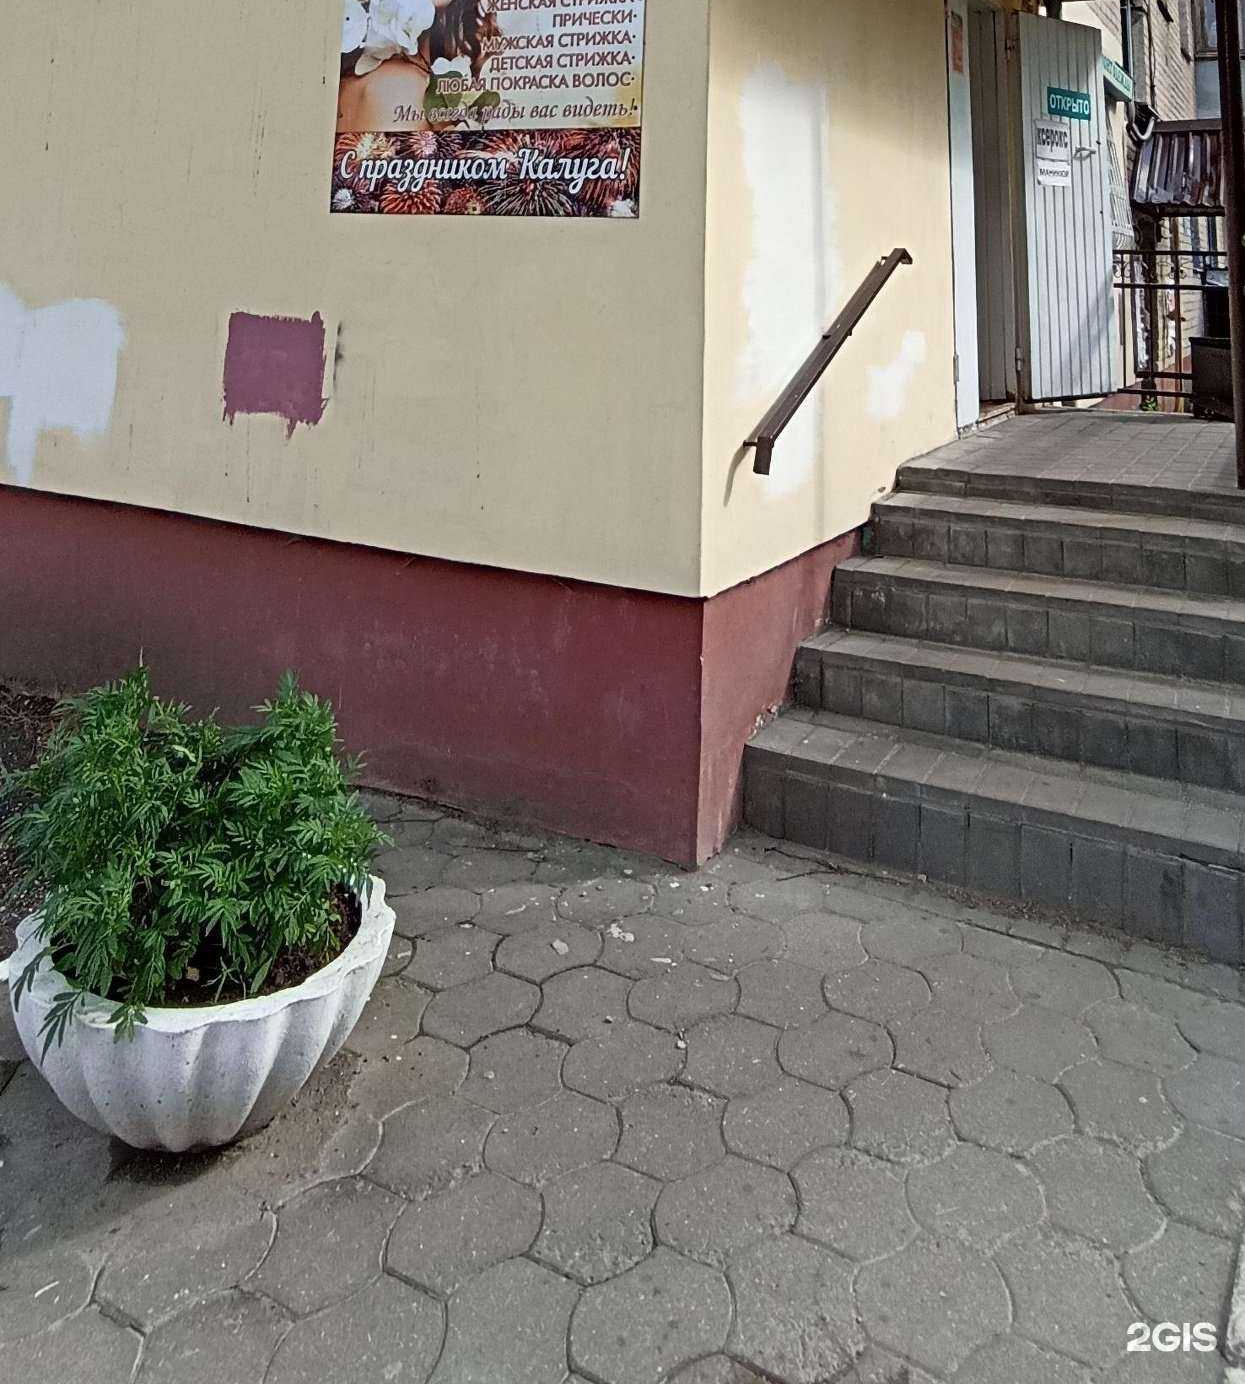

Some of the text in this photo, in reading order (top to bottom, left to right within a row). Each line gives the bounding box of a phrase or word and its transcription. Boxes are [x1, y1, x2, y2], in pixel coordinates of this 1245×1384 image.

[481, 34, 554, 53] МУЖСКАЯ
[489, 54, 553, 73] ДЕТСКАЯ
[436, 76, 487, 93] ЛЮБАЯ
[490, 74, 569, 91] ПОКРАСКА
[393, 105, 424, 122] Мы
[530, 104, 557, 118] вас
[562, 95, 636, 118] видеть!
[1049, 94, 1090, 114] ОТКРЫТО
[340, 147, 632, 194] С праздником Калуга!
